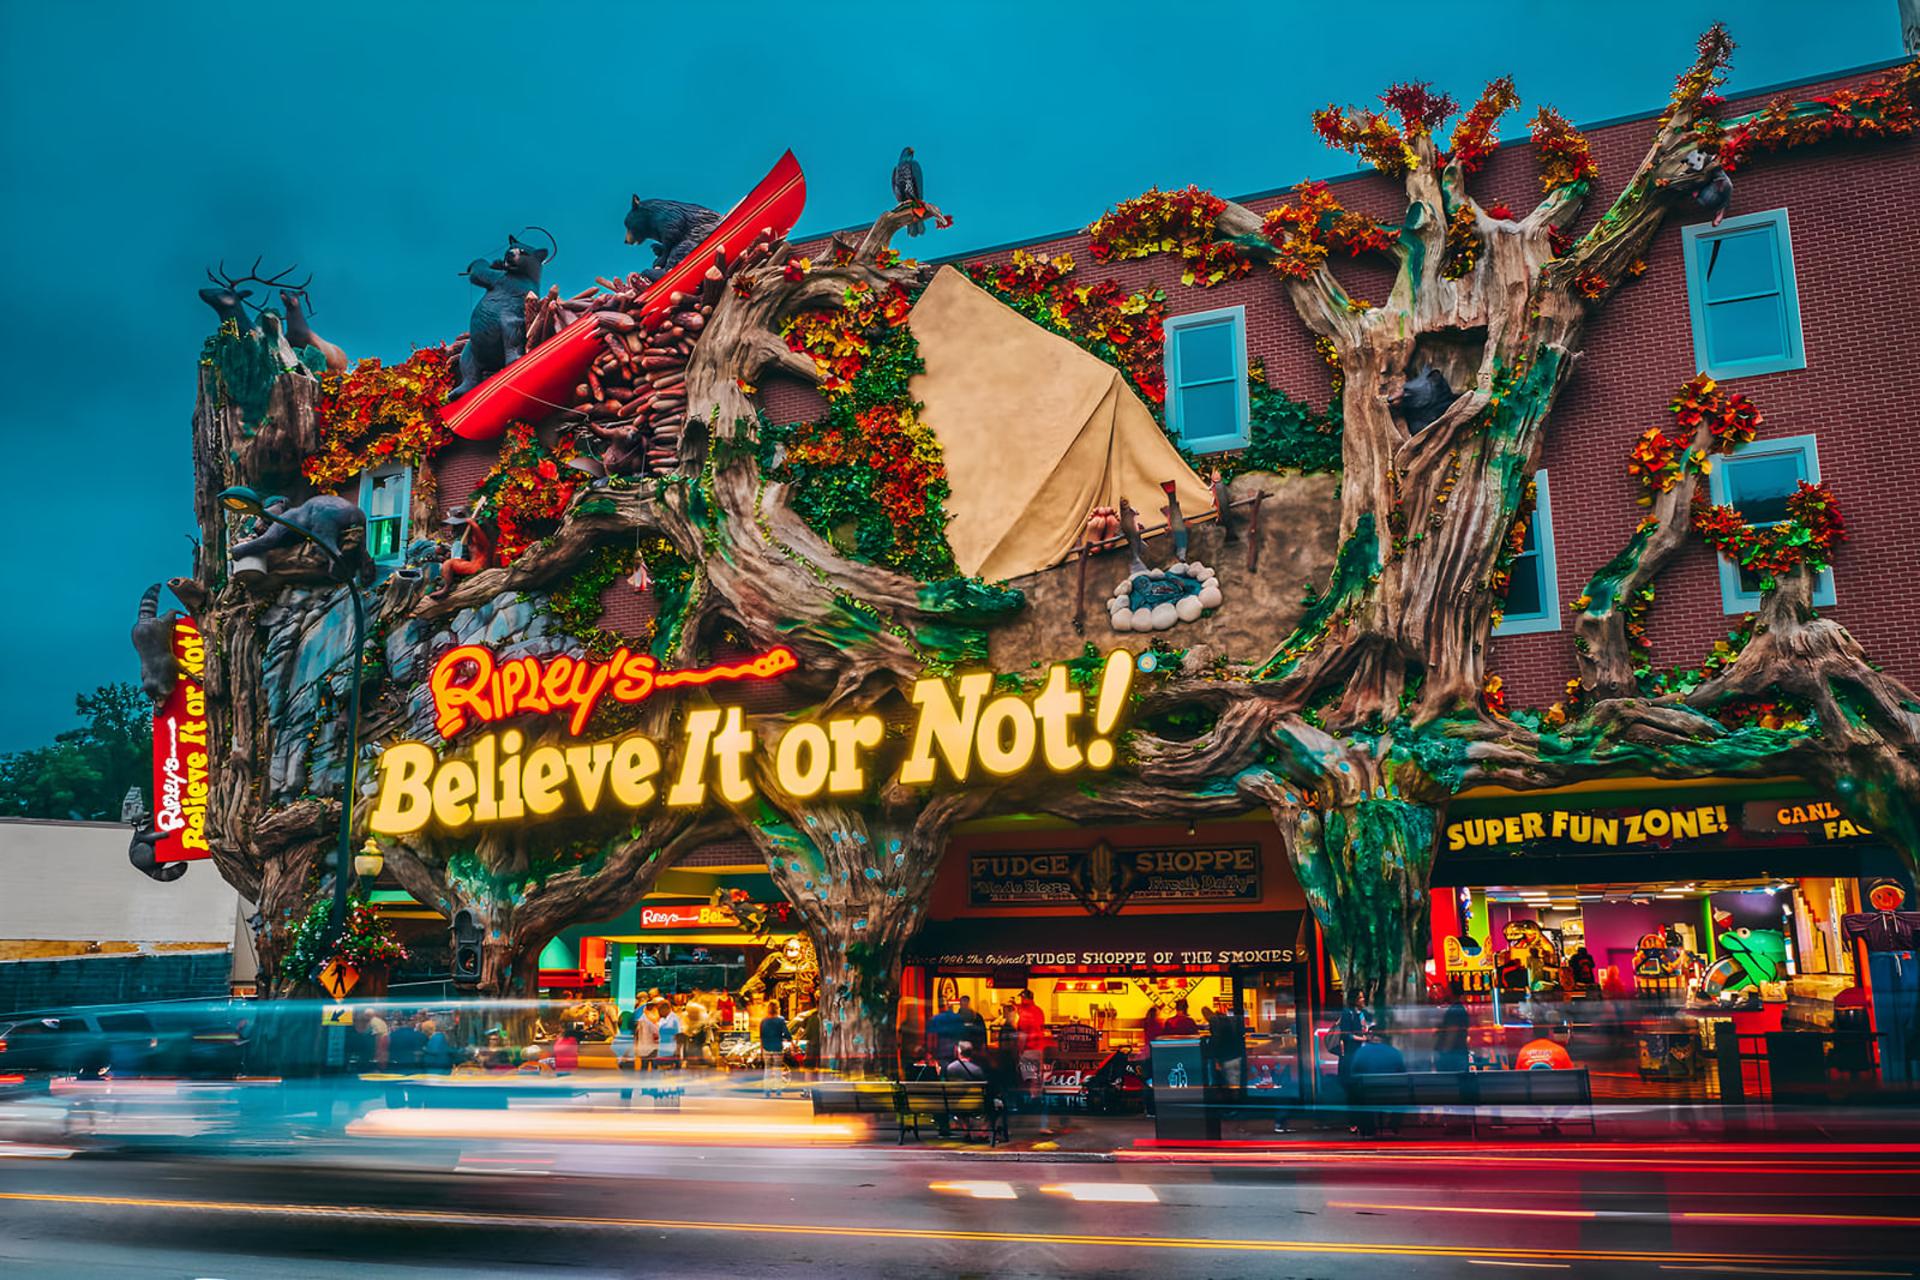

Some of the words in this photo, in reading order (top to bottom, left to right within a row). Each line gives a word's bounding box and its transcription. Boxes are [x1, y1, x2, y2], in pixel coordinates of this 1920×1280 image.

[185, 685, 205, 716] or
[179, 720, 208, 746] It
[369, 728, 661, 834] Believe
[667, 706, 755, 806] It
[776, 715, 884, 797] or
[900, 648, 1134, 784] Not!
[181, 752, 209, 851] Believe
[1447, 811, 1546, 851] SUPER
[1551, 810, 1619, 846] FUN
[1624, 805, 1729, 844] ZONE!
[971, 855, 1070, 878] FUDGE
[1135, 849, 1256, 873] SHOPPE
[985, 953, 1026, 965] Original
[1025, 951, 1076, 965] FUDGE
[1081, 951, 1146, 965] SHOPPE
[1153, 951, 1173, 964] OF
[1181, 950, 1213, 964] THE
[1217, 949, 1294, 963] SMOKIES
